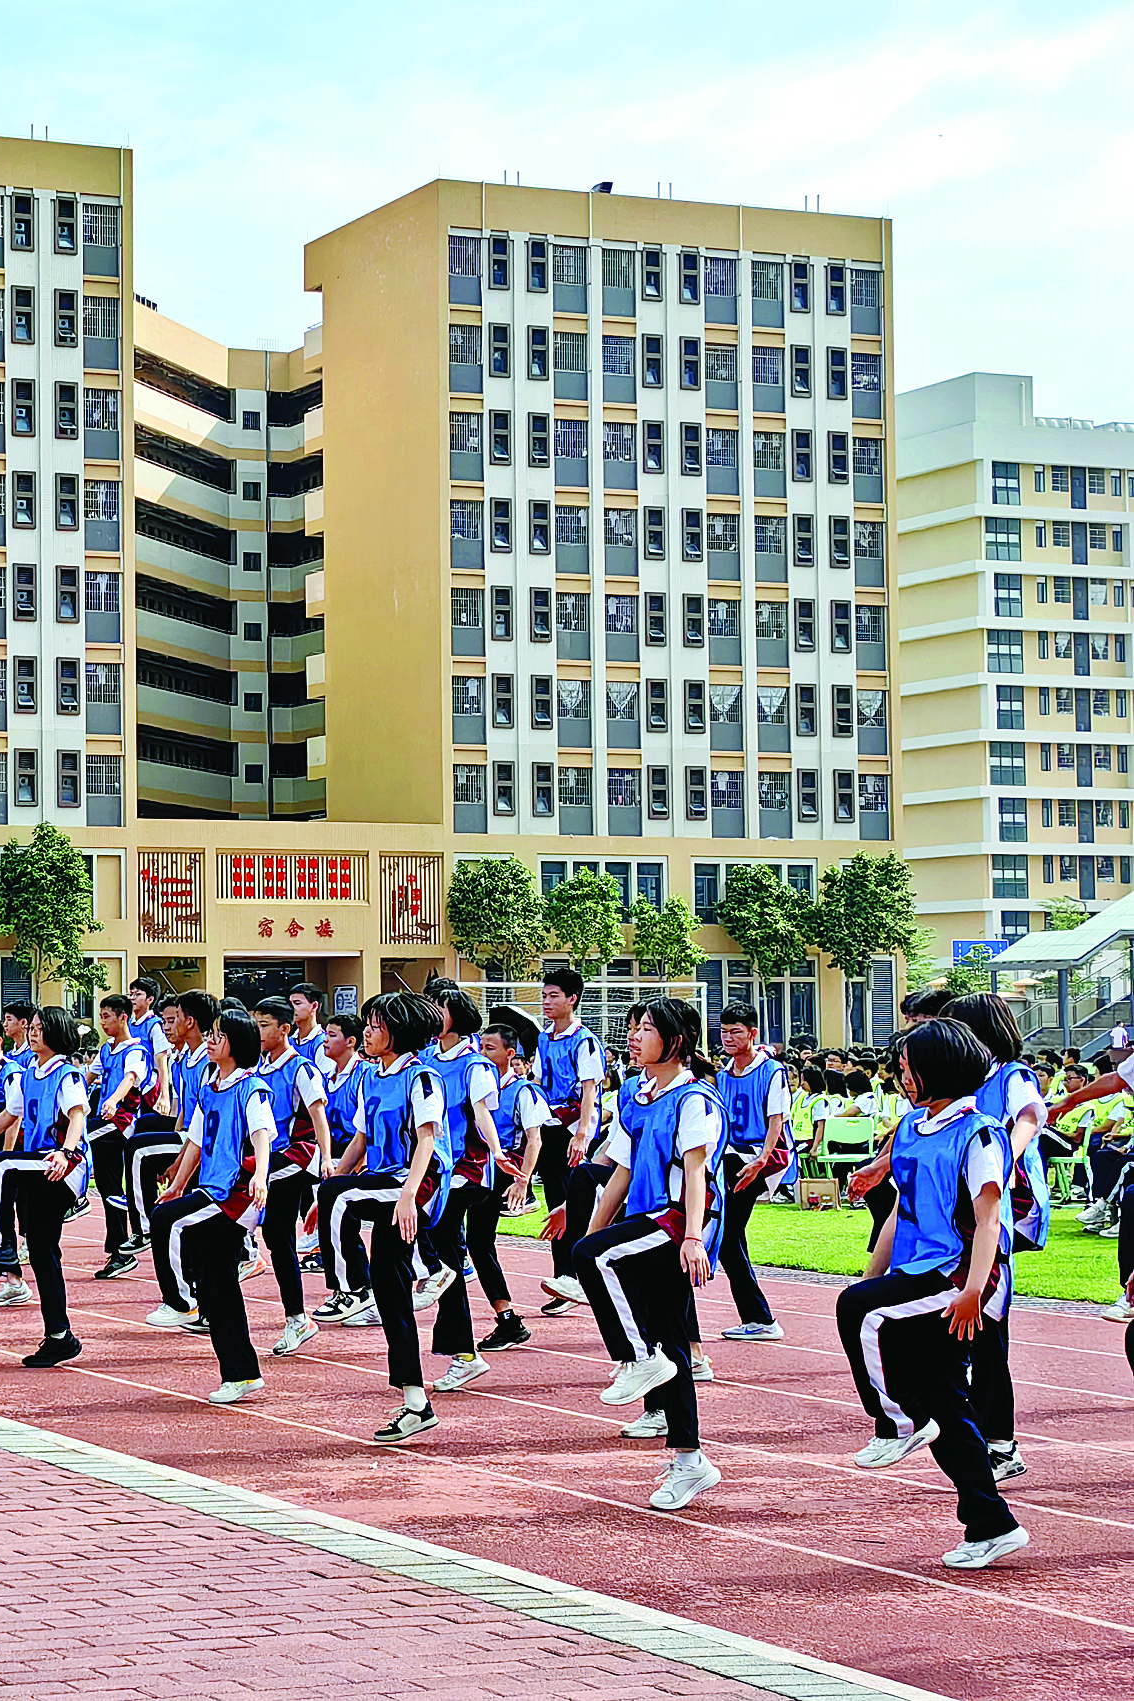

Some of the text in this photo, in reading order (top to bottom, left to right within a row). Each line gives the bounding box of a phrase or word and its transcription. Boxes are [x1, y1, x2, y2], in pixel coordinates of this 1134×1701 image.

[258, 916, 334, 938] 宿舍楼
[205, 1110, 220, 1157] 9
